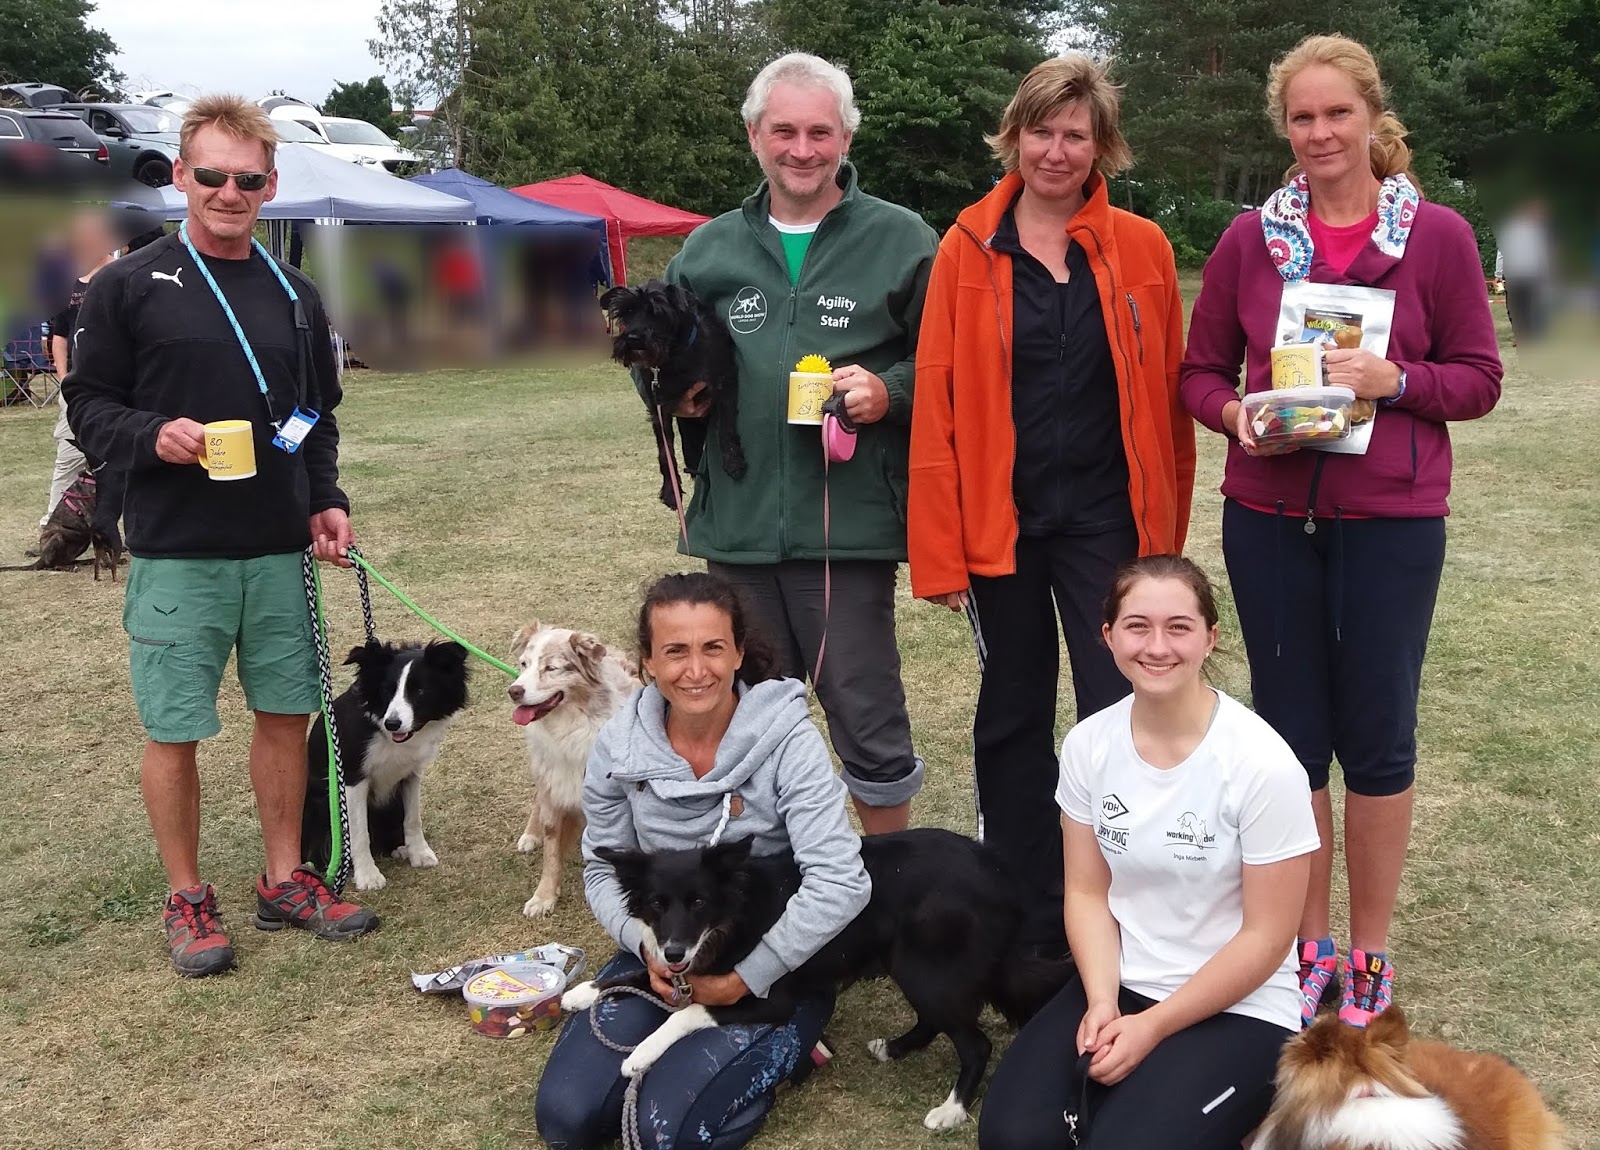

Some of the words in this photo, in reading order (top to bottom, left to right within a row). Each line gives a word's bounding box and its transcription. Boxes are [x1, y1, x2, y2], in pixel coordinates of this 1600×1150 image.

[816, 295, 857, 312] Agility
[820, 315, 850, 329] Staff
[1102, 799, 1120, 813] VDH
[1111, 830, 1127, 847] DOG
[1166, 830, 1194, 843] working
[1173, 852, 1185, 861] Inga
